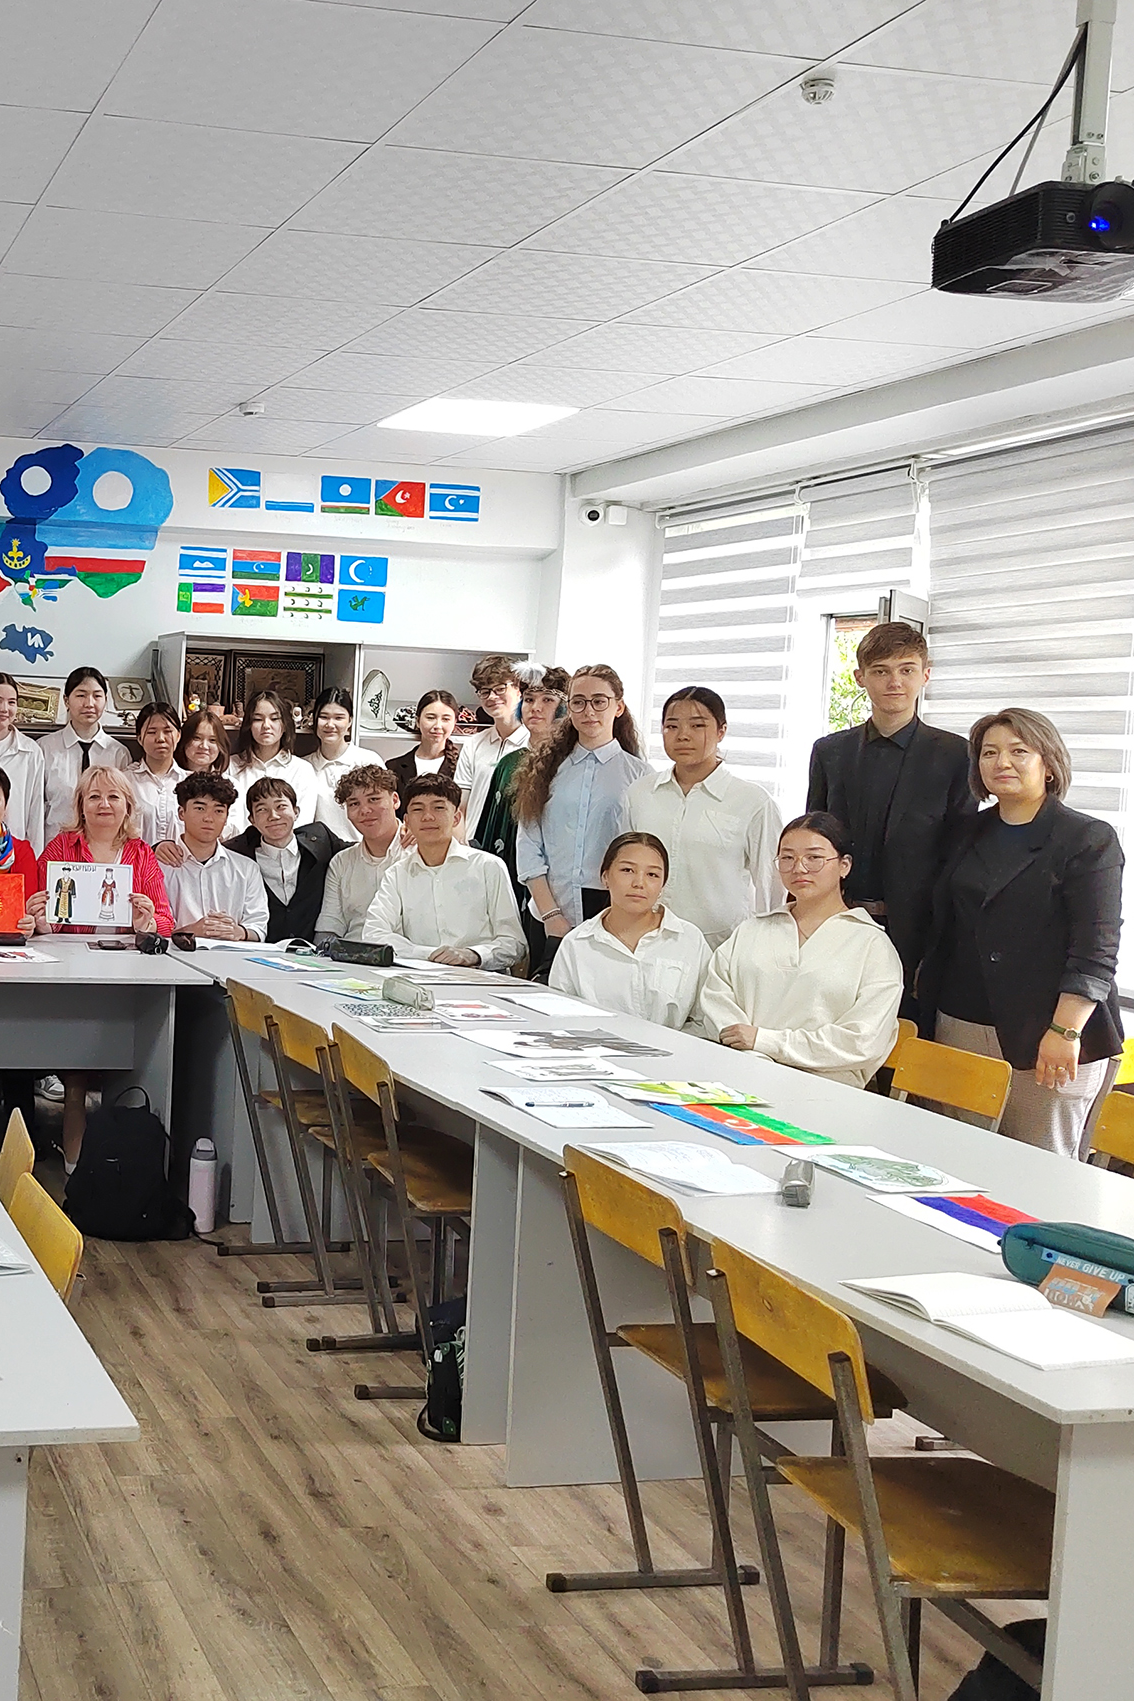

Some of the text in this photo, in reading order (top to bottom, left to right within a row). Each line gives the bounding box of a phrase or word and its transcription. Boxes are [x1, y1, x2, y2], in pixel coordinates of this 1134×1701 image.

[1055, 1255, 1126, 1283] NEVER GIVE UP
